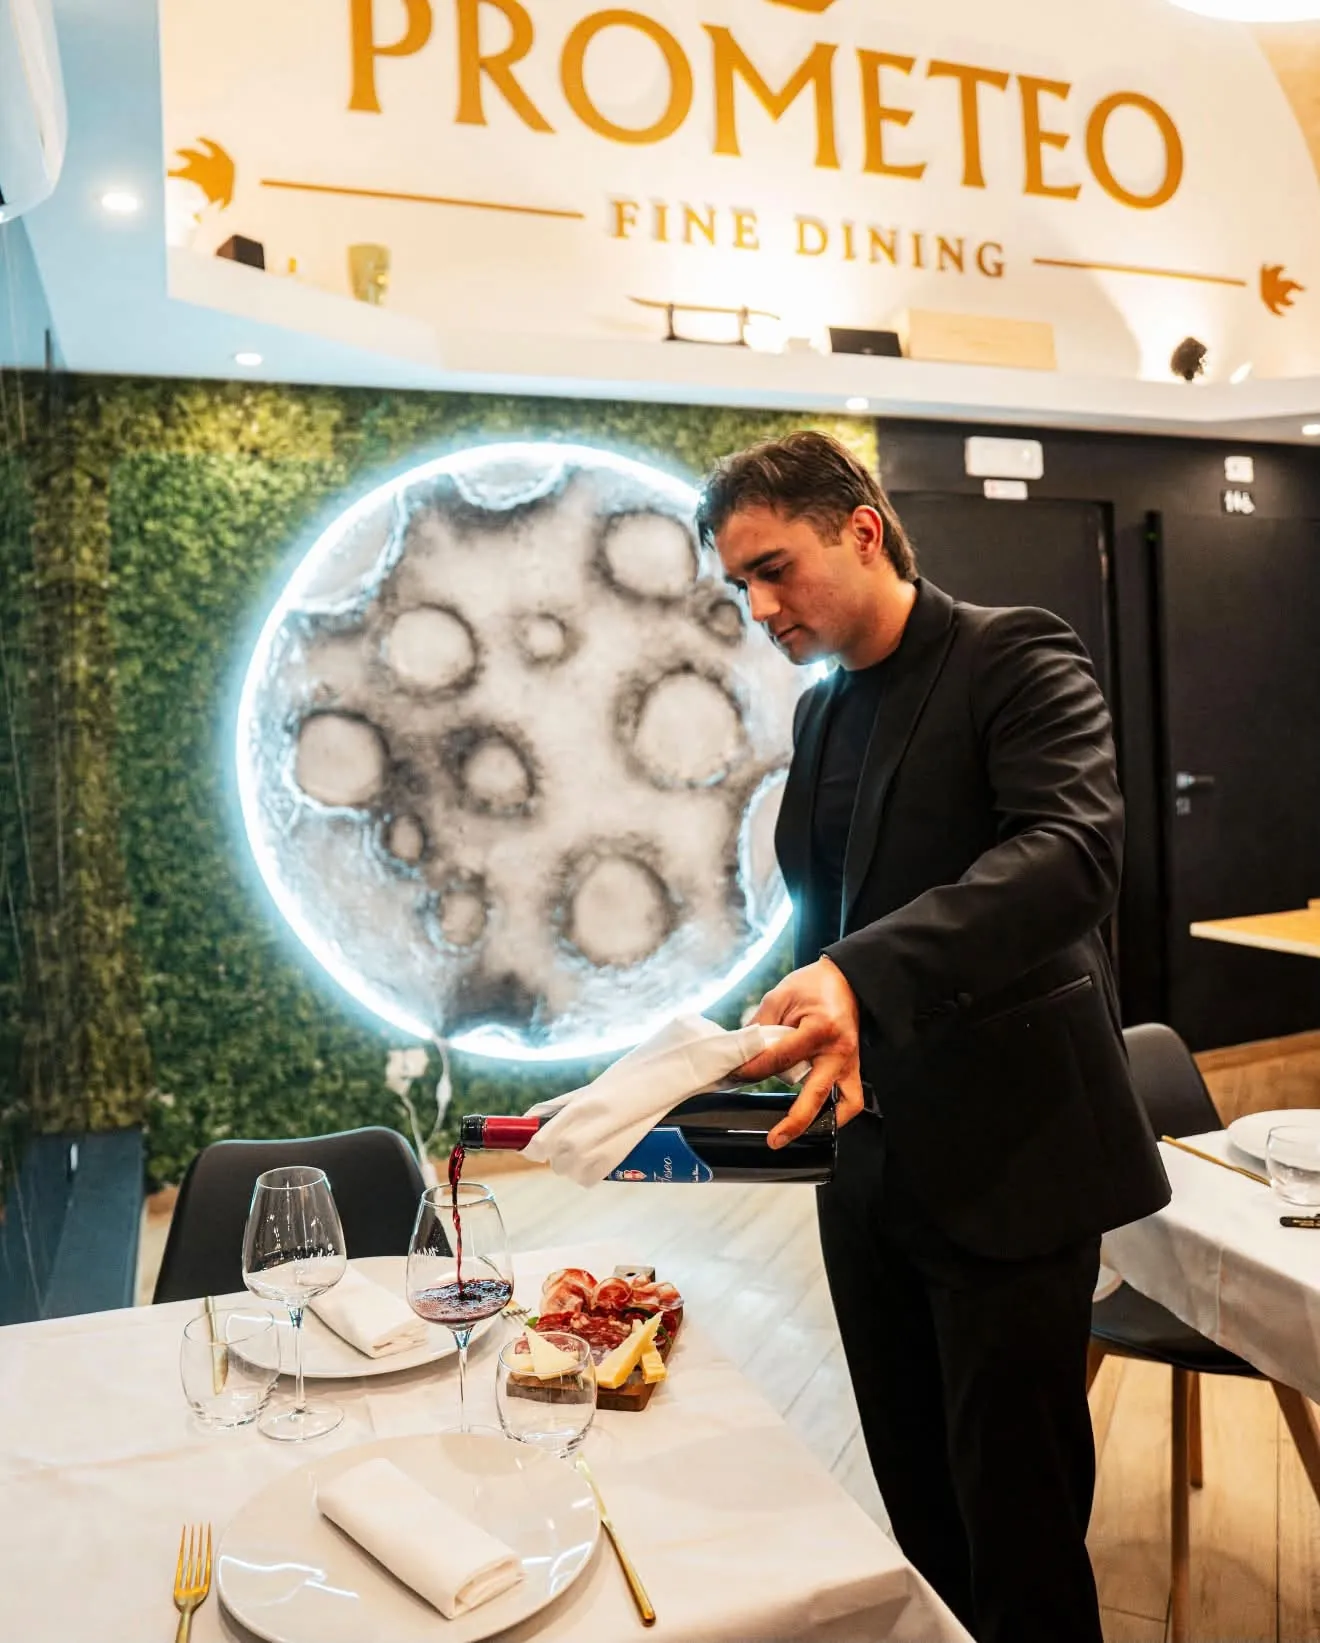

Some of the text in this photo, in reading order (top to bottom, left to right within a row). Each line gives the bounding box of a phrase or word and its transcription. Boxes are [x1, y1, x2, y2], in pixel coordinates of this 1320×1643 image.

[348, 0, 1184, 210] PROMETEO
[611, 199, 1006, 278] FINE DINING
